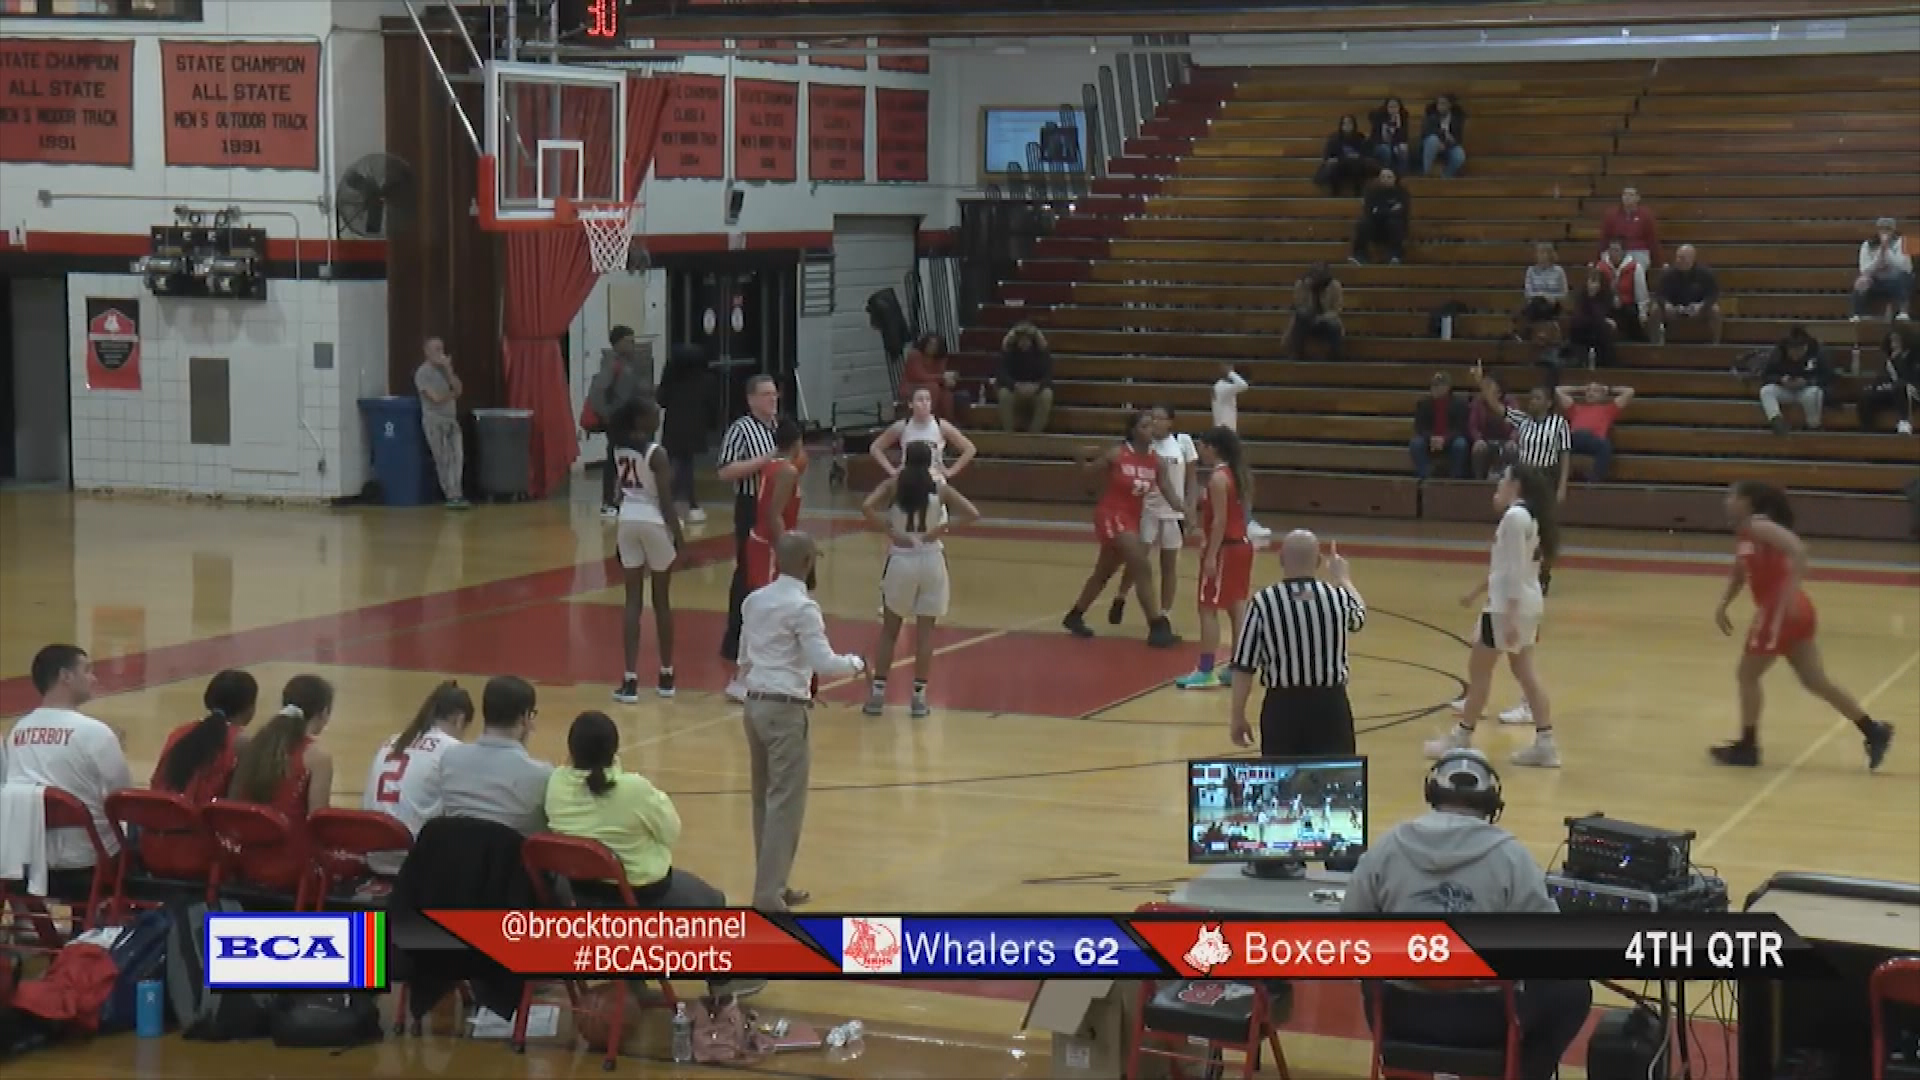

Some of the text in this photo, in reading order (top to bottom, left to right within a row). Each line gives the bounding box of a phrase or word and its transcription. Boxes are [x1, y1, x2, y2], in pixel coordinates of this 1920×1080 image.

[45, 52, 119, 71] CHAMPION
[176, 55, 306, 74] STATE CHAMPION
[9, 79, 106, 99] ALL STATE
[192, 83, 291, 102] ALL STATE
[215, 111, 266, 129] OUTDOOR
[272, 113, 308, 131] TRACK
[221, 139, 261, 155] 1991
[619, 456, 643, 488] 21
[376, 753, 410, 803] 2
